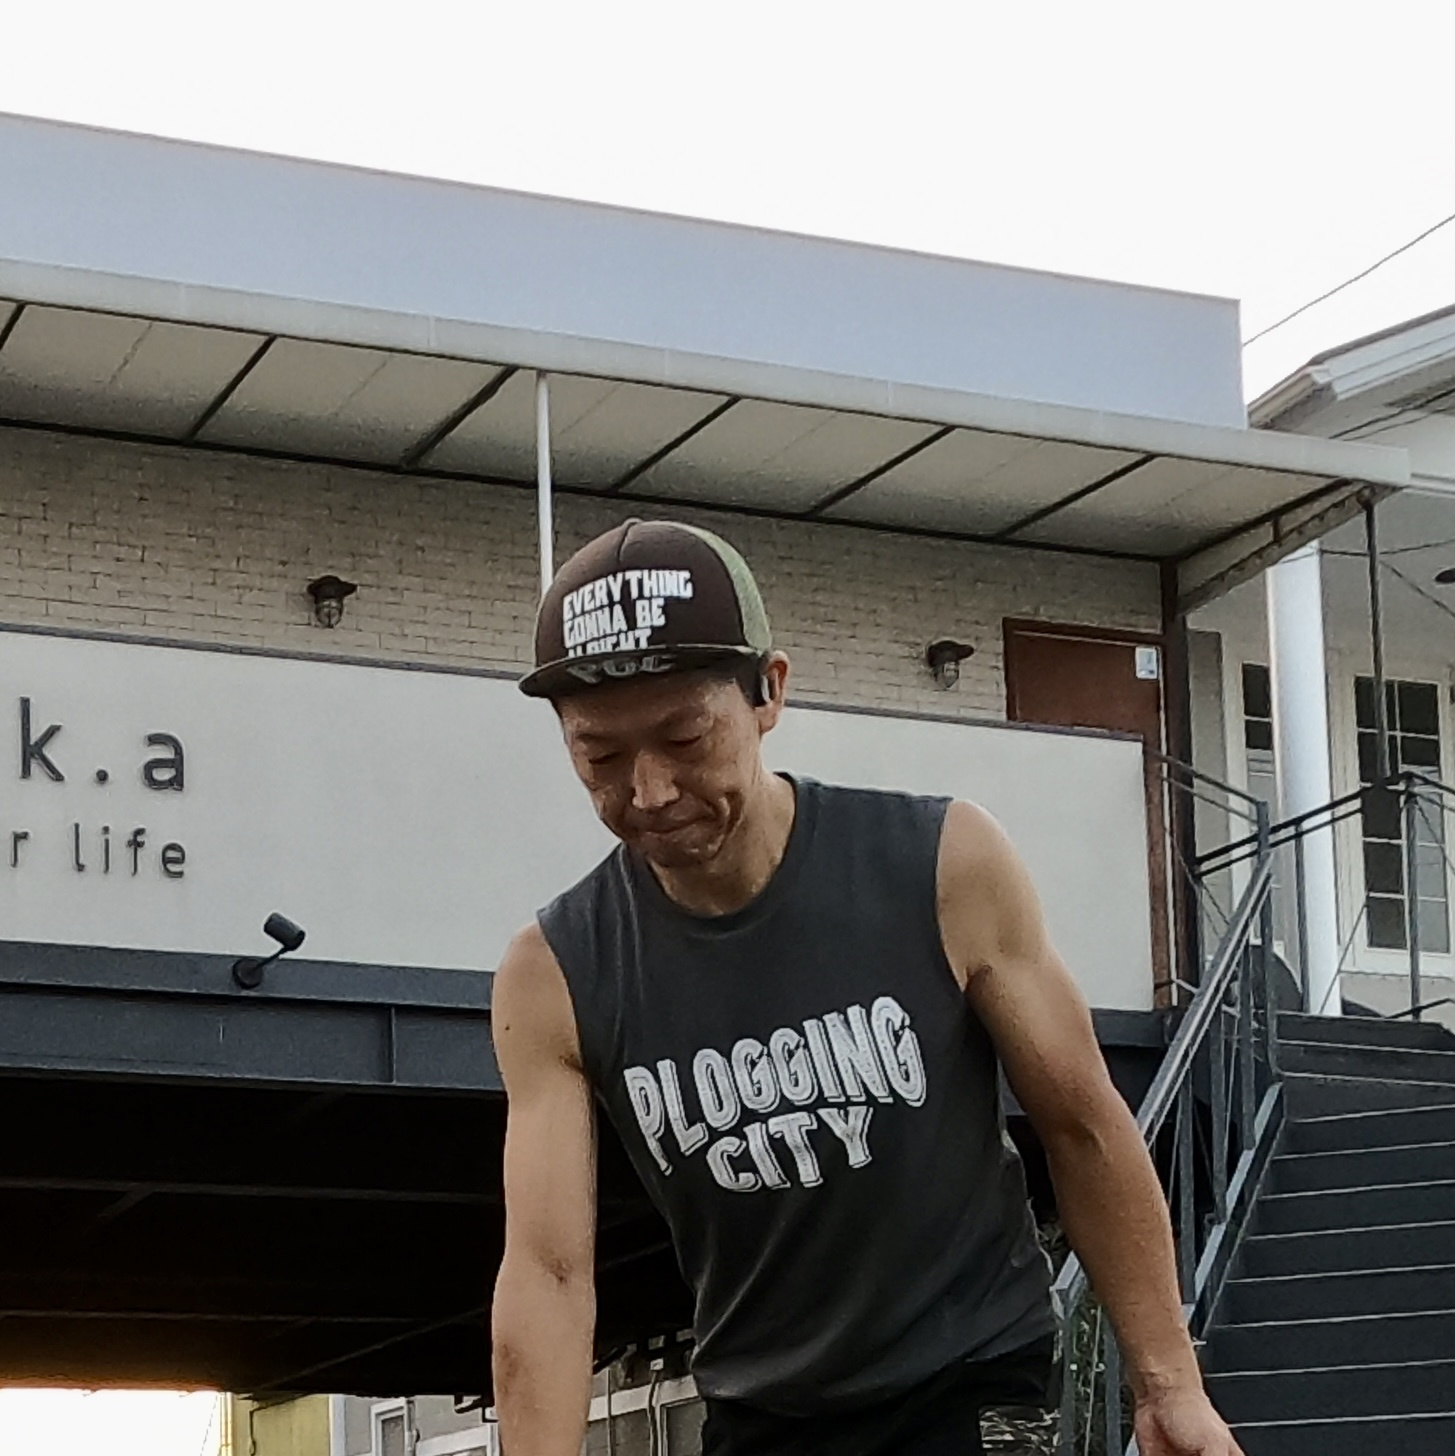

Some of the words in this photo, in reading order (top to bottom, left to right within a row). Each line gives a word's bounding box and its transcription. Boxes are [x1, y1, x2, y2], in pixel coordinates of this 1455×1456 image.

[563, 569, 694, 620] EVERYTHING
[563, 603, 628, 649] GONNA
[635, 597, 666, 628] BE
[73, 823, 187, 879] life
[623, 996, 927, 1176] PLOGGING
[705, 1105, 874, 1193] CITY
